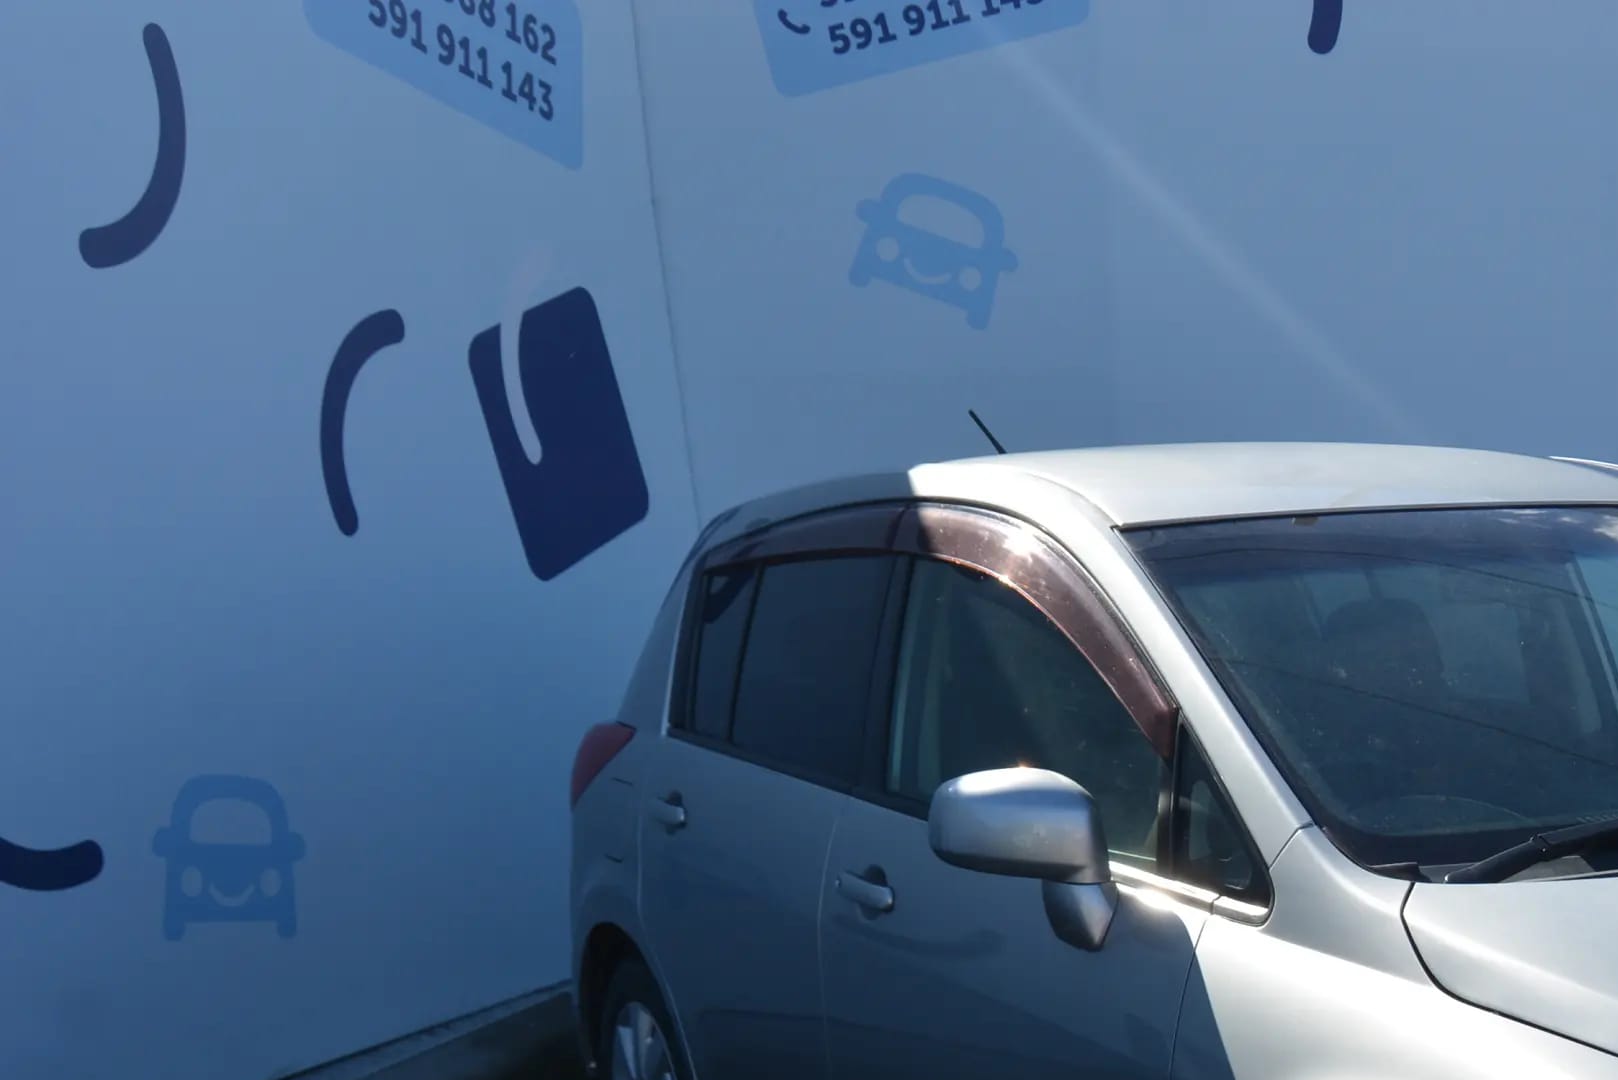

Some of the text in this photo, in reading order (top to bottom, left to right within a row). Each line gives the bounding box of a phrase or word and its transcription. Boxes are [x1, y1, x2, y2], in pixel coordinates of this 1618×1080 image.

[505, 2, 557, 66] 162
[828, 12, 897, 55] 591
[902, 0, 970, 36] 911
[368, 0, 428, 54] 591
[437, 24, 493, 89] 911
[501, 60, 554, 121] 143
